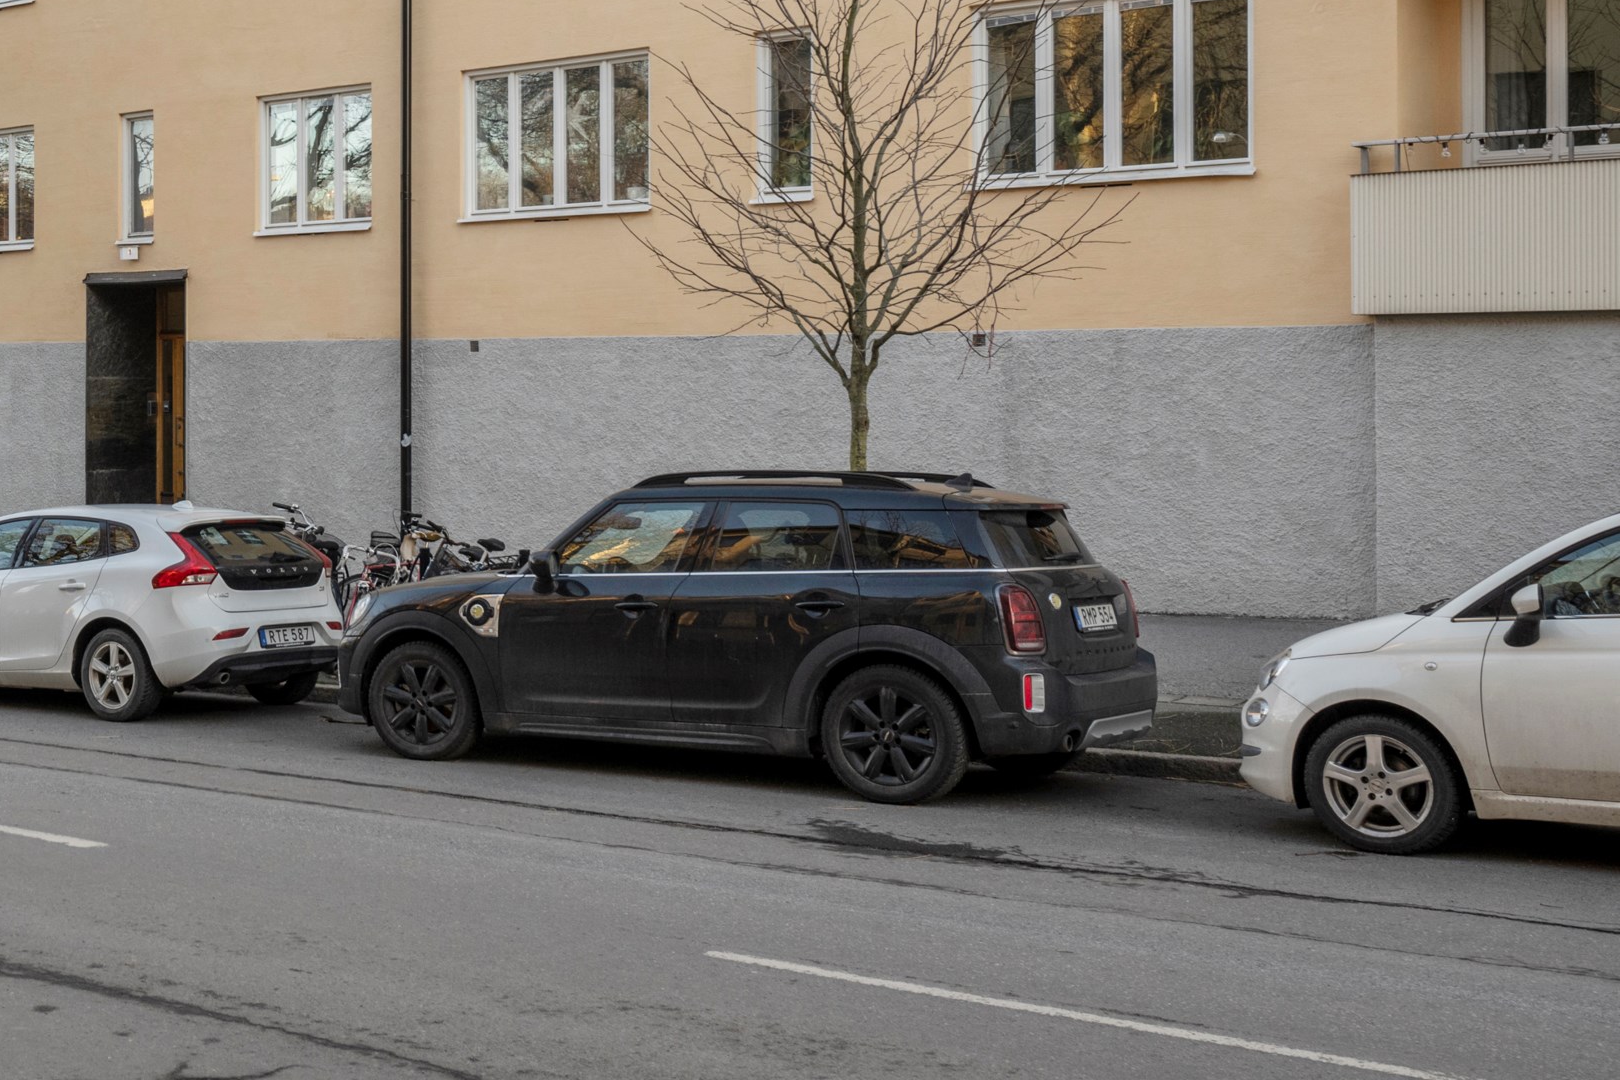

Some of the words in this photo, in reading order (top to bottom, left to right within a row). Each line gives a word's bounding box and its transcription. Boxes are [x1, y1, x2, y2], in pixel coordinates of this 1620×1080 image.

[251, 566, 309, 575] VOLVO
[1081, 607, 1098, 625] RMP
[1097, 606, 1114, 624] 554
[268, 629, 290, 643] RTE
[291, 627, 310, 641] 587
